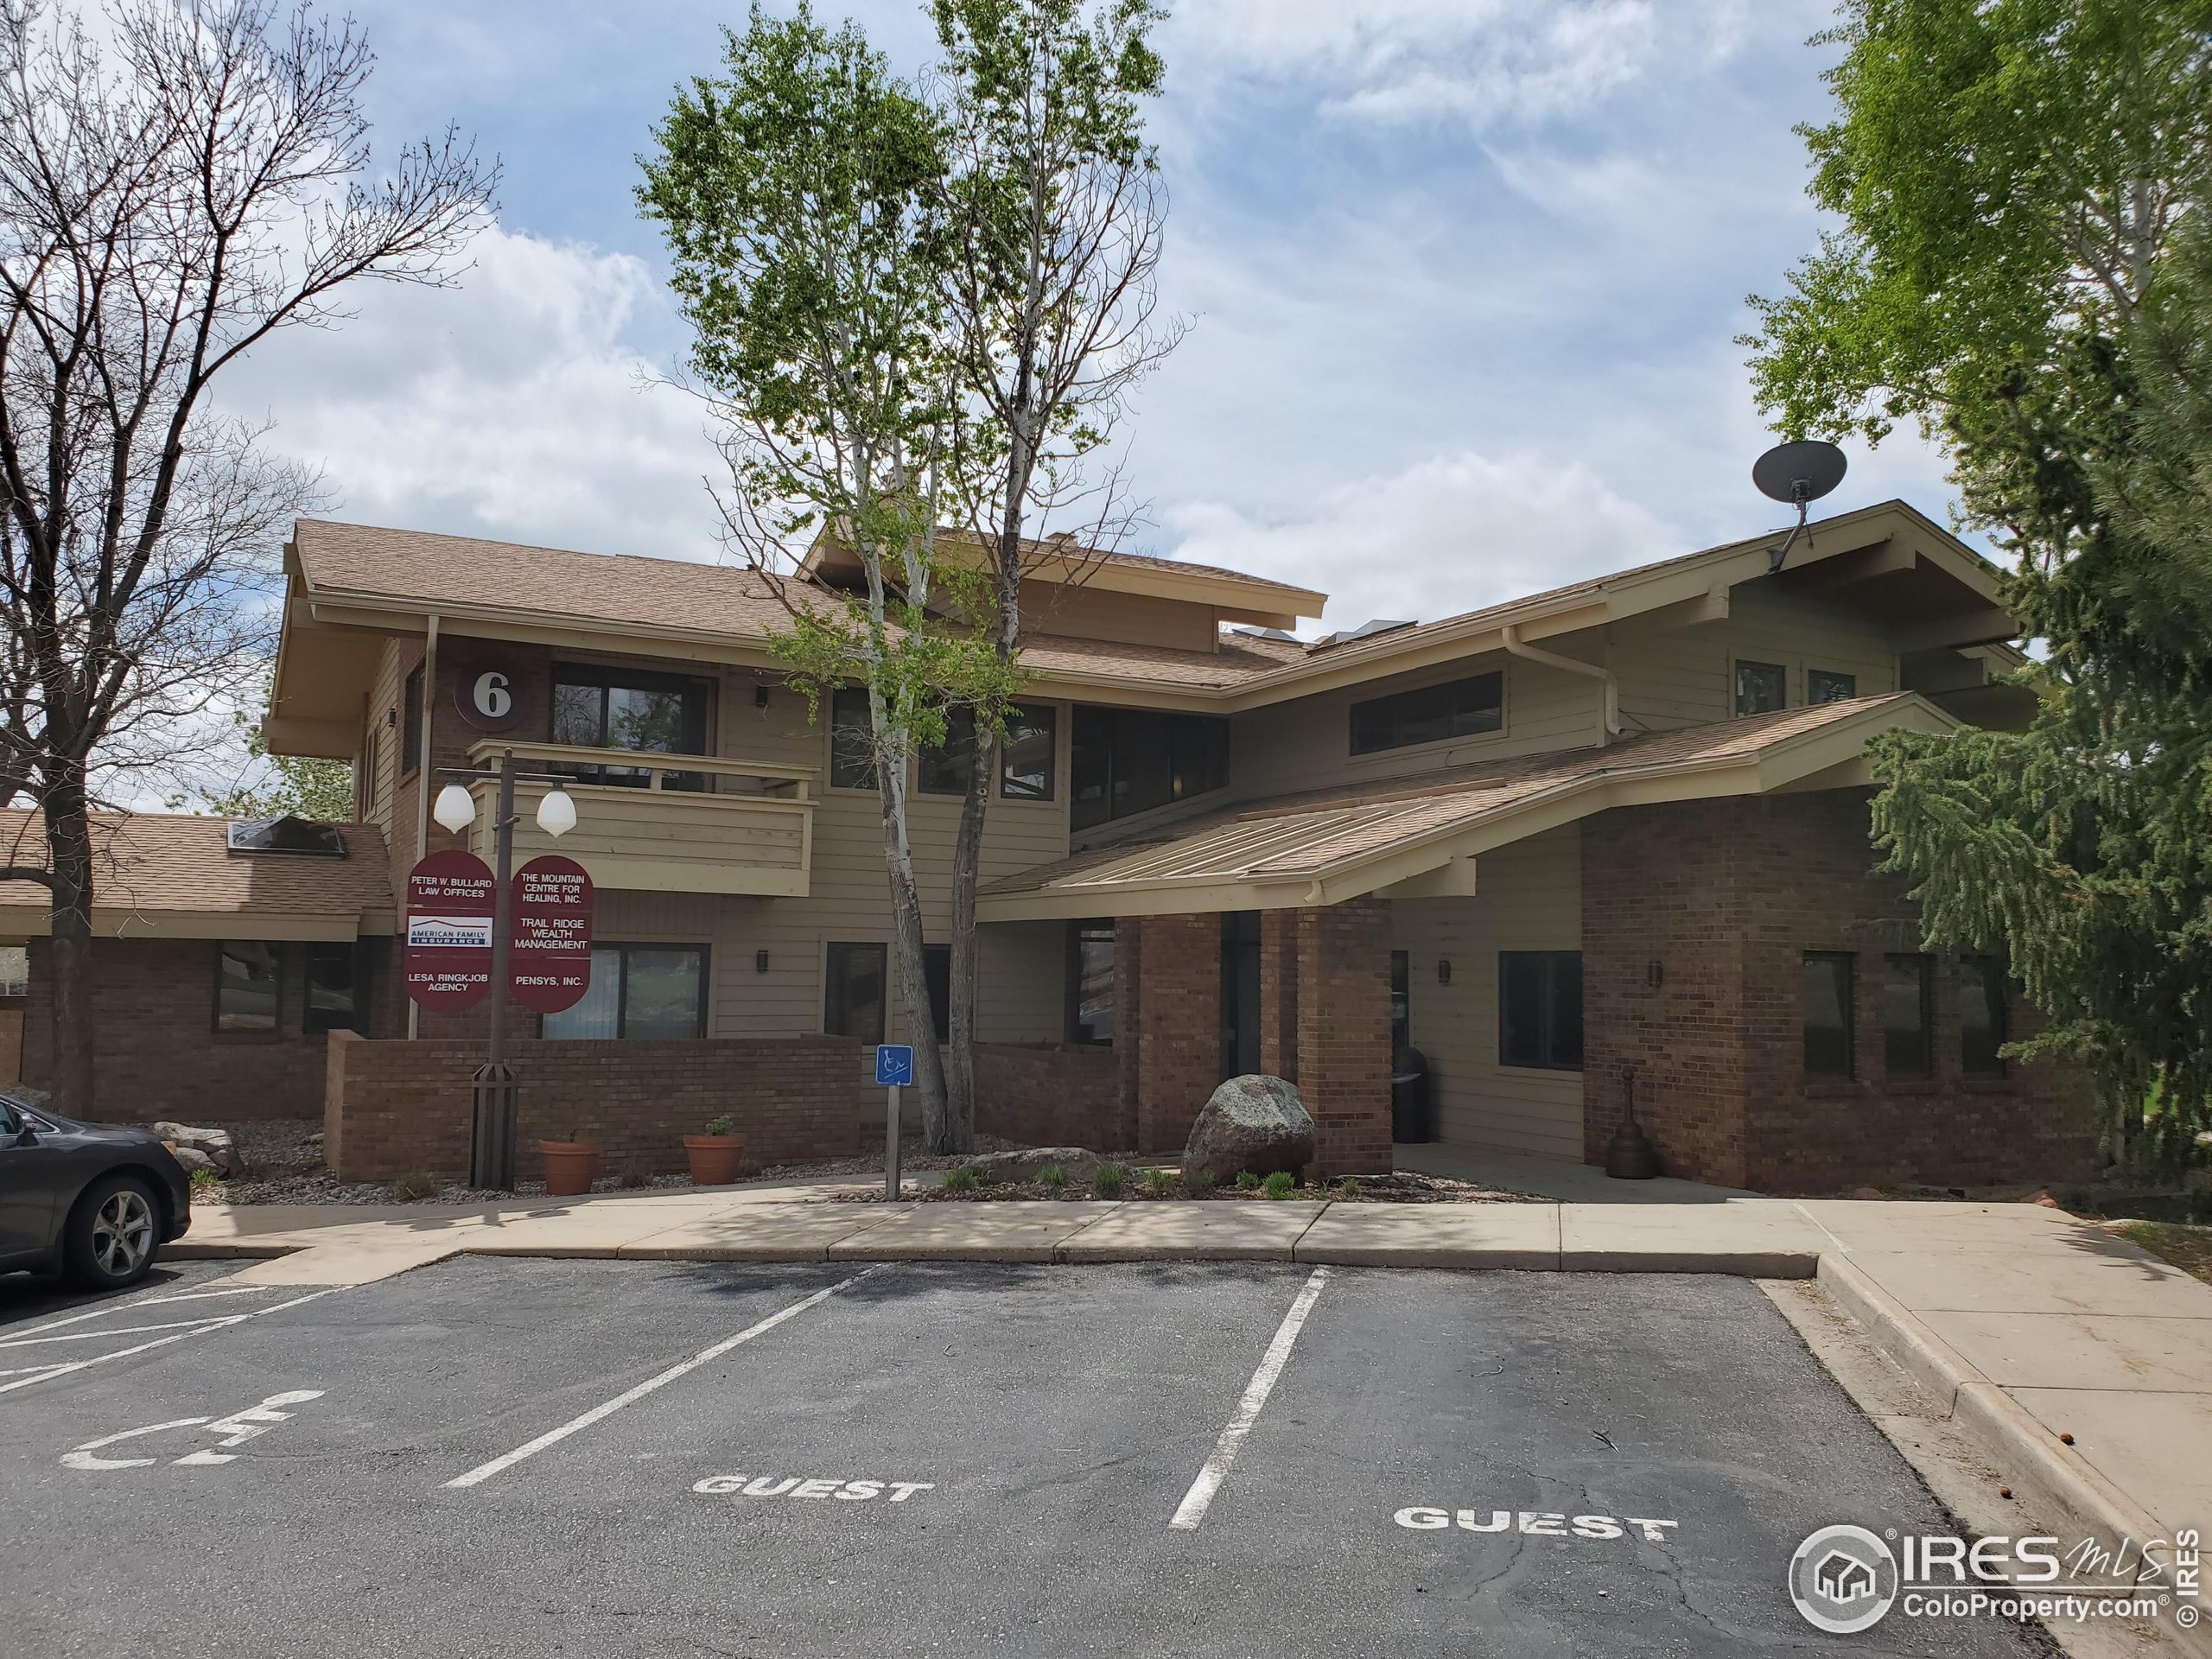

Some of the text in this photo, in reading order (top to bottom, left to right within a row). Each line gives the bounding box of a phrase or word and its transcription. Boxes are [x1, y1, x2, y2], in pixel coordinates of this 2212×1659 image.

[473, 671, 512, 717] 6
[411, 875, 493, 888] PETER W. BULLARD
[521, 873, 585, 883] THE MOUNTAIN
[418, 887, 486, 898] LAW OFFICES
[524, 883, 580, 893] CENTRE FOR
[522, 893, 582, 905] HEALING, INC.
[520, 918, 585, 929] TRAIL RIDGE
[531, 928, 573, 938] WEALTH
[514, 939, 588, 950] MANAGEMENT
[409, 973, 435, 982] LESA
[515, 976, 583, 987] PENSYS, INC.
[692, 1475, 937, 1502] GUEST
[1394, 1506, 1679, 1541] GUEST
